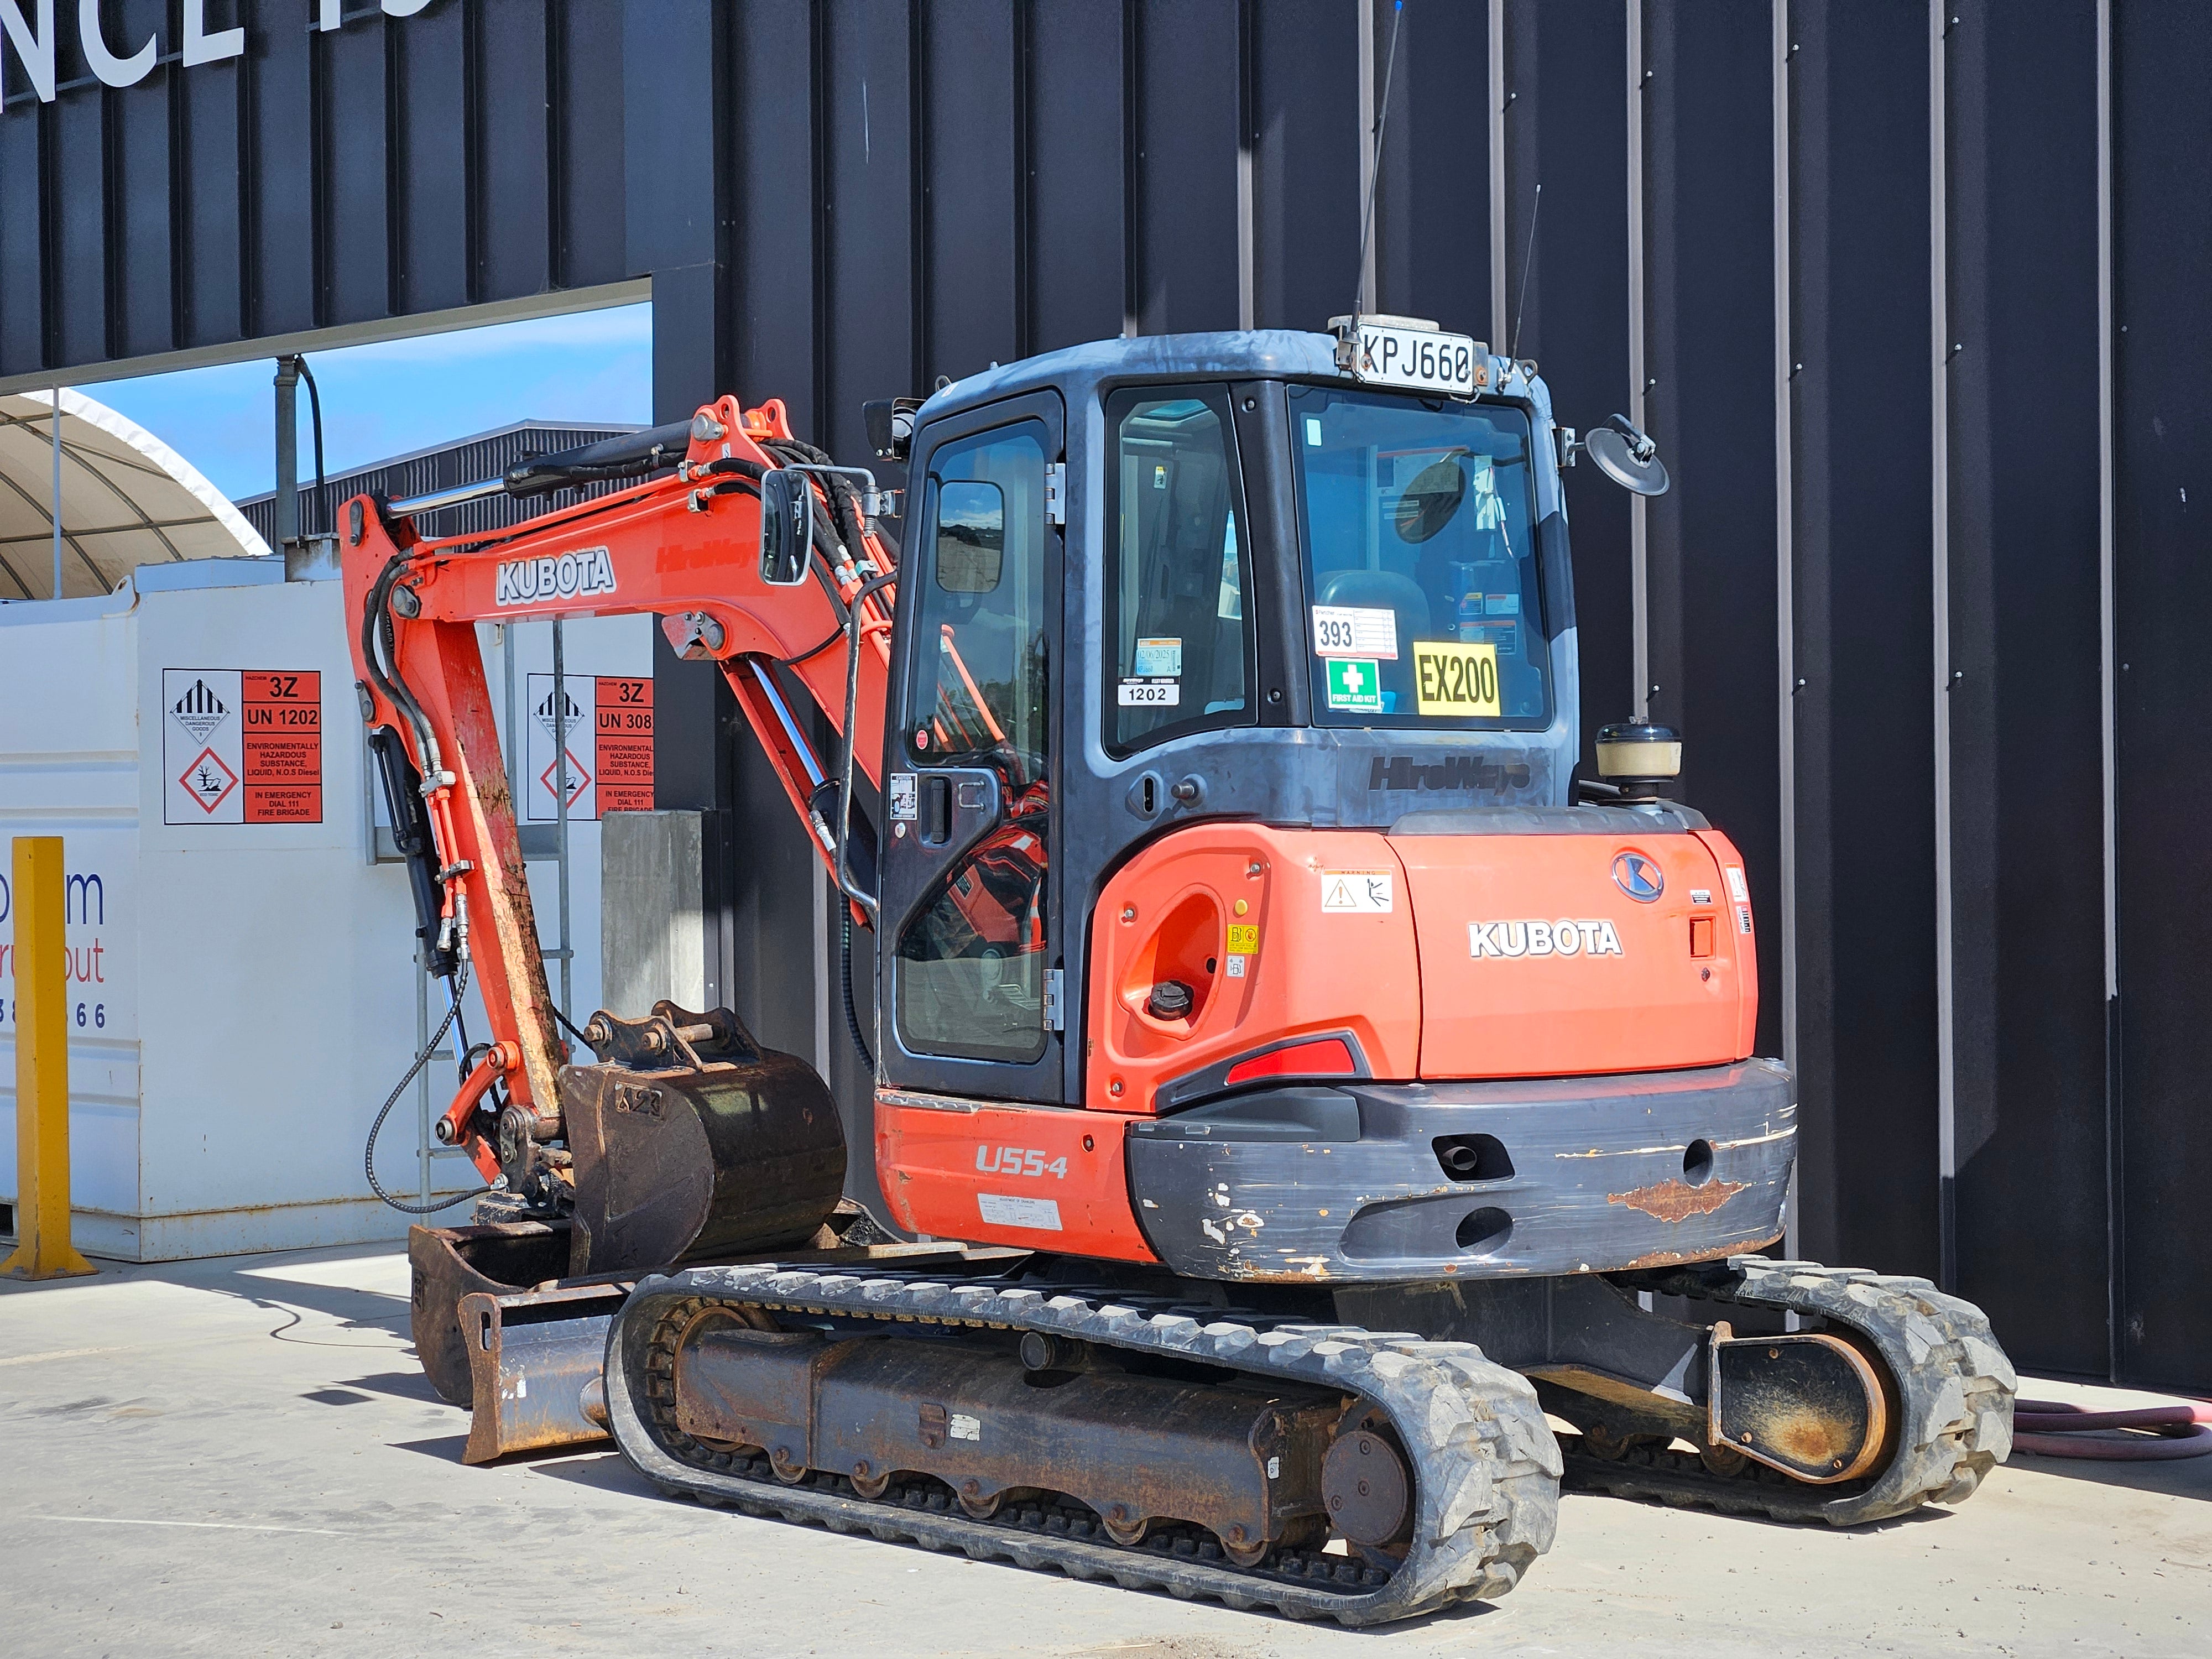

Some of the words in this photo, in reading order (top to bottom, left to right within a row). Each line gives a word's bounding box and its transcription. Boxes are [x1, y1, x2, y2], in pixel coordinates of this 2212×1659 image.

[1363, 334, 1469, 383] KPJ660
[498, 550, 614, 600] KUBOTA
[1319, 620, 1352, 647] 393
[269, 676, 298, 697] 3Z
[1418, 654, 1495, 703] EX200
[619, 682, 644, 702] 3Z
[1129, 688, 1166, 701] 1202
[1332, 693, 1352, 702] FIRST
[1352, 694, 1364, 703] AID
[1364, 695, 1376, 703] KIT
[248, 709, 273, 724] UN
[279, 709, 318, 725] 1202
[599, 713, 621, 728] UN
[626, 714, 654, 729] 308
[260, 760, 307, 768] SUBSTANCE,
[1468, 920, 1623, 957] KUBOTA
